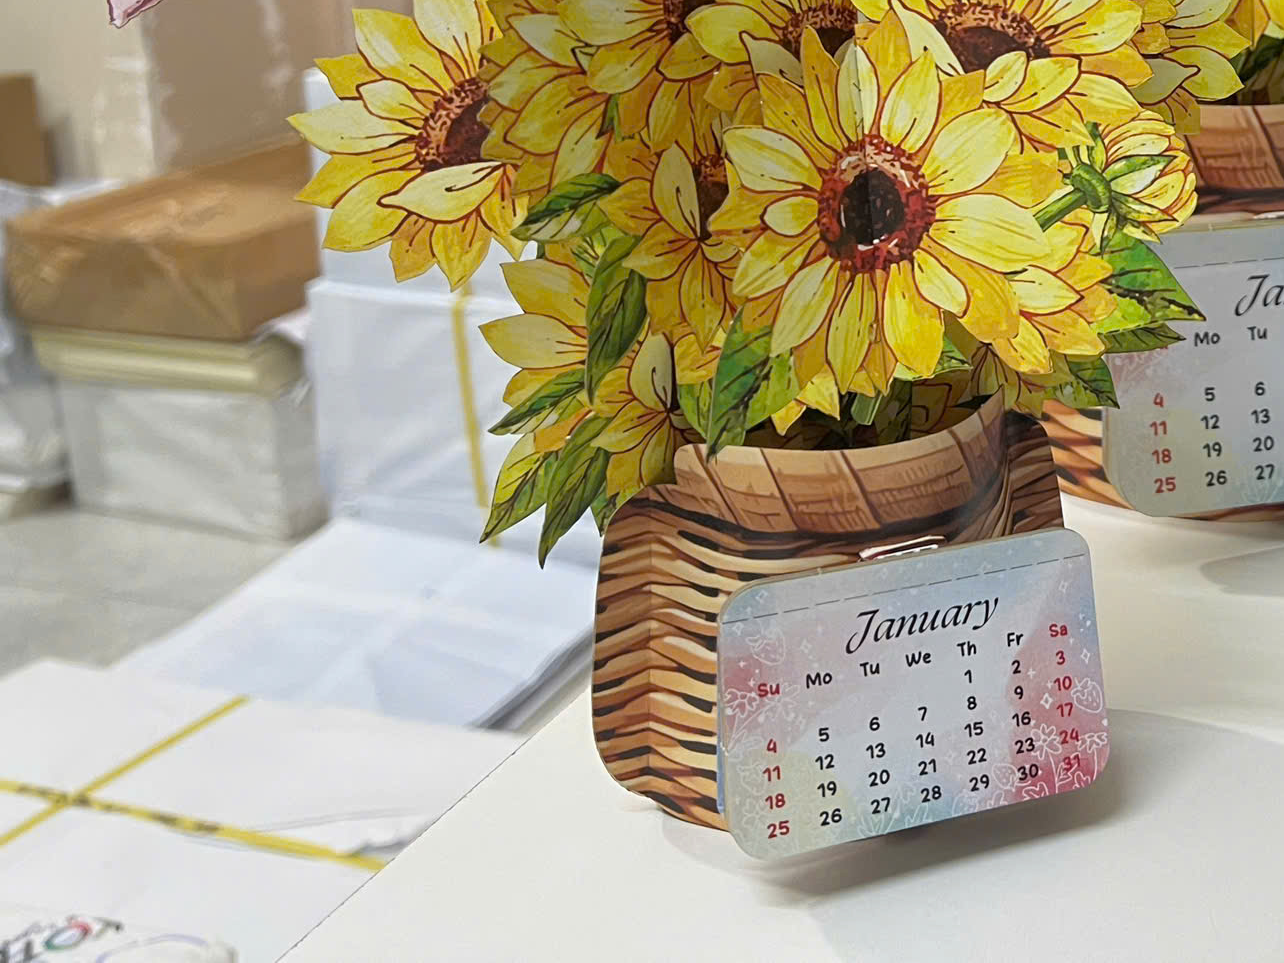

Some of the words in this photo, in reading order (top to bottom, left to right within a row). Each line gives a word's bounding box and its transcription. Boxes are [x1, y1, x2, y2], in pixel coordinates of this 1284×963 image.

[1193, 331, 1221, 348] Mo
[1246, 325, 1268, 341] Tu
[1152, 392, 1164, 408] 4
[1204, 386, 1216, 402] 5
[1254, 381, 1266, 397] 6
[1149, 420, 1168, 437] 11
[1200, 414, 1220, 430] 12
[1250, 408, 1271, 425] 13
[1151, 448, 1172, 465] 18
[1202, 441, 1223, 458] 19
[1252, 435, 1275, 453] 20
[1153, 476, 1177, 494] 25
[1205, 469, 1228, 488] 26
[1254, 463, 1275, 481] 27
[845, 597, 999, 654] January
[757, 682, 781, 699] Su
[805, 671, 833, 690] Mo
[859, 661, 880, 677] Tu
[905, 650, 932, 668] We
[956, 640, 977, 657] Th
[1006, 631, 1024, 648] Fr
[1048, 623, 1068, 638] Sa
[964, 669, 973, 684] 1
[1011, 659, 1022, 675] 2
[1055, 650, 1066, 666] 3
[766, 738, 778, 754] 4
[818, 727, 830, 743] 5
[869, 716, 881, 732] 6
[917, 706, 928, 722] 7
[966, 695, 978, 711] 8
[1013, 685, 1024, 700] 9
[1053, 675, 1073, 692] 10
[762, 765, 781, 782] 11
[814, 753, 835, 771] 12
[865, 742, 886, 760] 13
[915, 731, 935, 749] 14
[963, 721, 984, 738] 15
[1011, 710, 1032, 728] 16
[1055, 701, 1074, 718] 17
[764, 792, 786, 810] 18
[816, 780, 837, 798] 19
[868, 769, 891, 788] 20
[917, 758, 937, 777] 21
[966, 747, 987, 766] 22
[1014, 737, 1036, 755] 23
[1058, 727, 1080, 745] 24
[766, 819, 790, 840] 25
[819, 807, 843, 827] 26
[870, 796, 891, 815] 27
[920, 785, 942, 804] 28
[969, 773, 990, 793] 29
[1017, 764, 1039, 780] 30
[1063, 755, 1082, 770] 31
